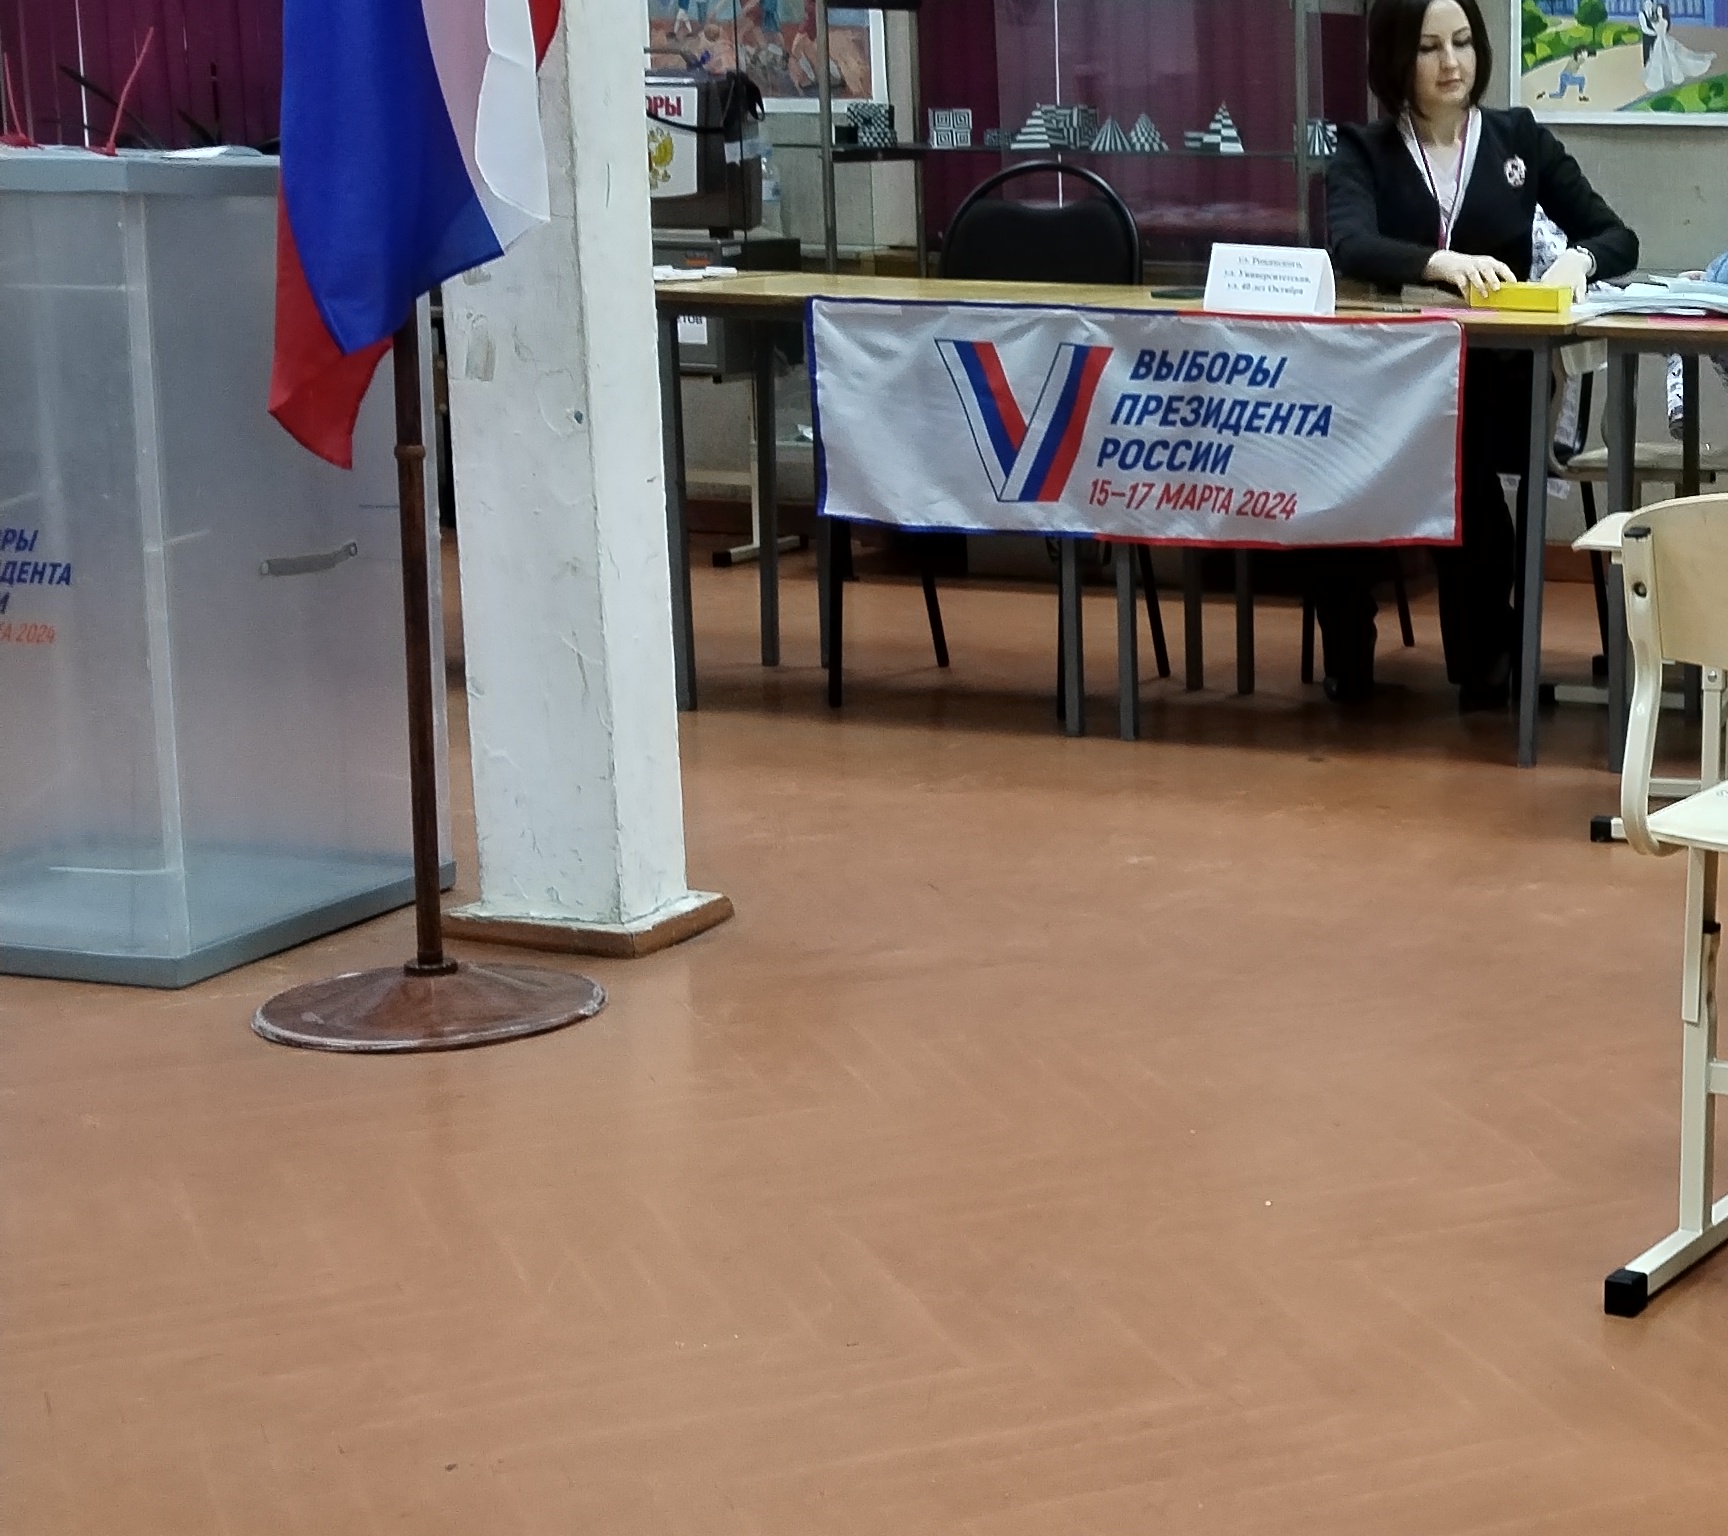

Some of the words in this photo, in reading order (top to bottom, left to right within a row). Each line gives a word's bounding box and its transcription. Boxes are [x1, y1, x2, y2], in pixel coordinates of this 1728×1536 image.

[1129, 349, 1288, 389] ВЫБОРЫ
[1110, 393, 1333, 437] ПРЕЗИДЕНТА
[1097, 437, 1234, 475] РОССИИ
[1156, 482, 1234, 515] МАРТА
[1236, 489, 1298, 521] 2024
[0, 528, 38, 552] РЫ
[0, 560, 71, 586] ДЕНТА
